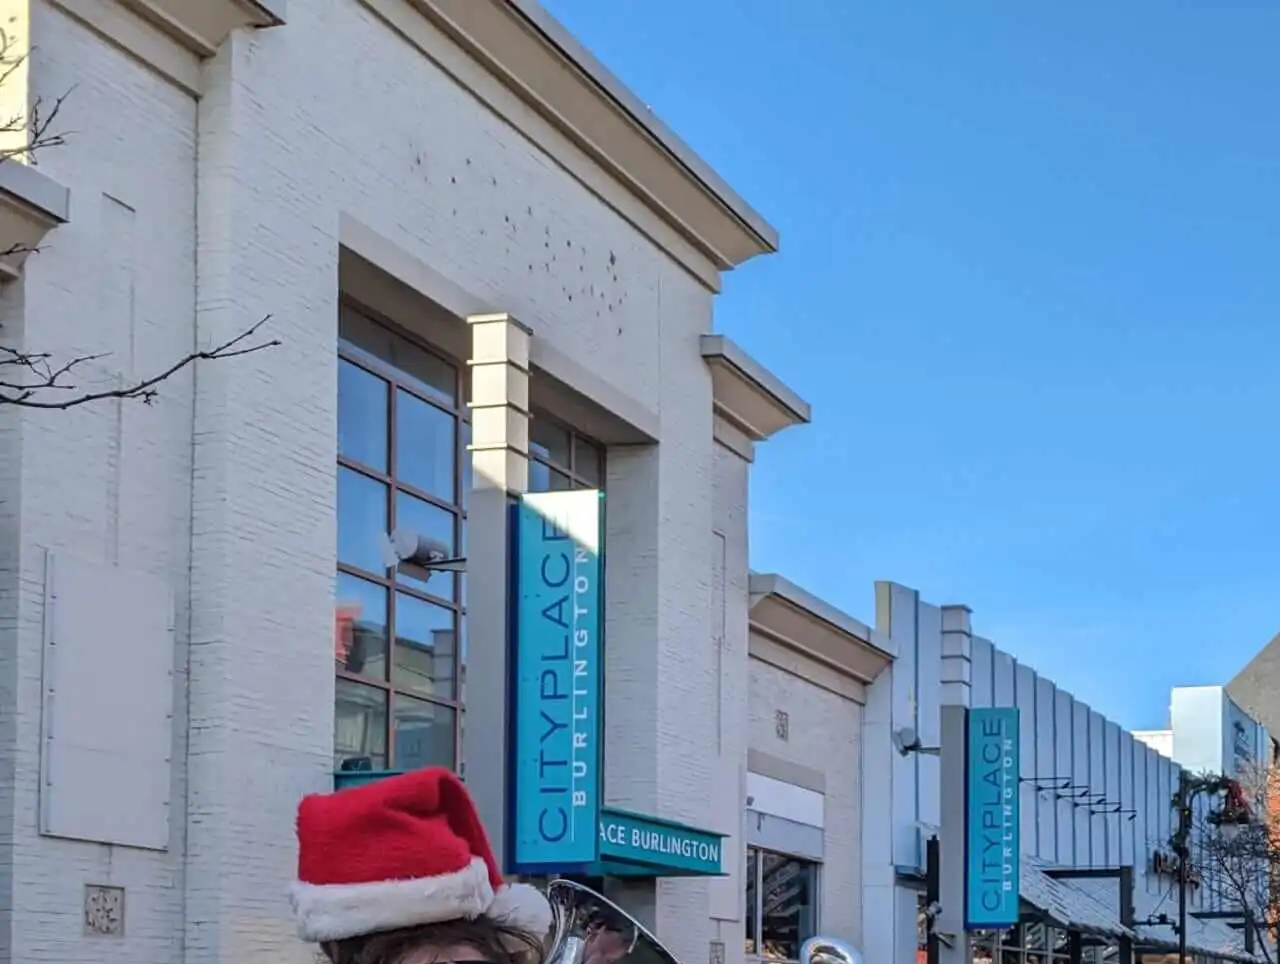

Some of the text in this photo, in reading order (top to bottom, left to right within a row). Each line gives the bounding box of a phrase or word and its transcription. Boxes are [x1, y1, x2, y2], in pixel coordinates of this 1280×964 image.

[538, 512, 571, 843] CITYPLACE
[573, 545, 589, 807] BURLINGTON
[631, 828, 719, 862] BURLINGTON
[981, 716, 1002, 912] CITYPLACE
[1003, 738, 1014, 891] BURLINGTON
